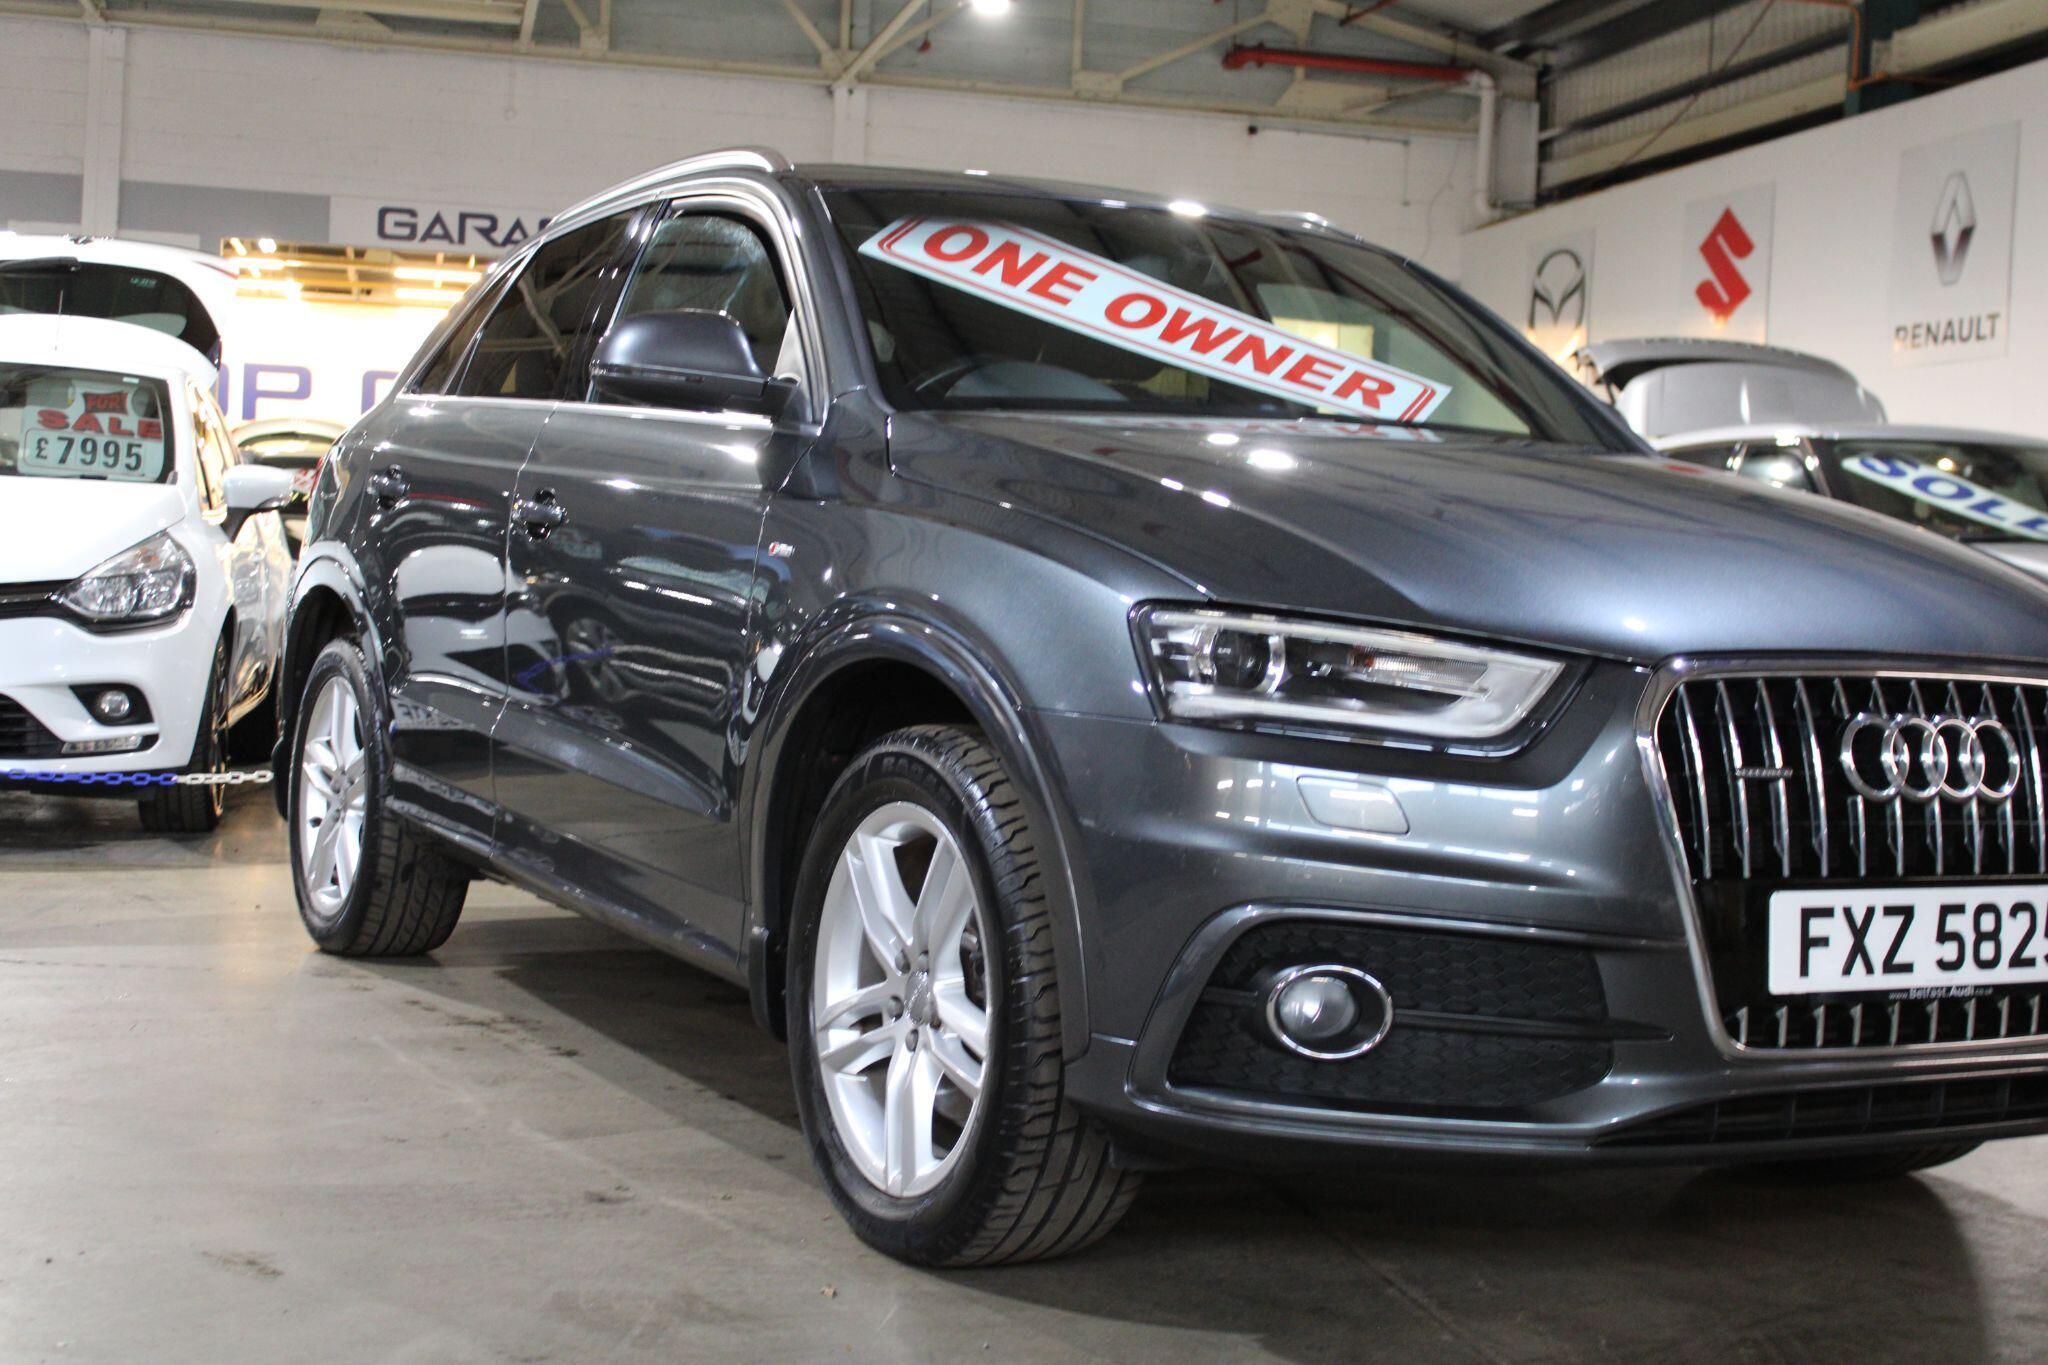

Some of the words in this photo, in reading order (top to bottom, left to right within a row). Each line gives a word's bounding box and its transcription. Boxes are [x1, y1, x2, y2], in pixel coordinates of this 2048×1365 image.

[924, 224, 1099, 306] ONE
[1104, 292, 1396, 412] OWNER
[1894, 312, 2000, 349] RENAULT
[37, 409, 163, 439] SALE
[35, 436, 142, 472] £7995
[1800, 904, 1915, 977] FXZ
[1936, 901, 2048, 972] 582
